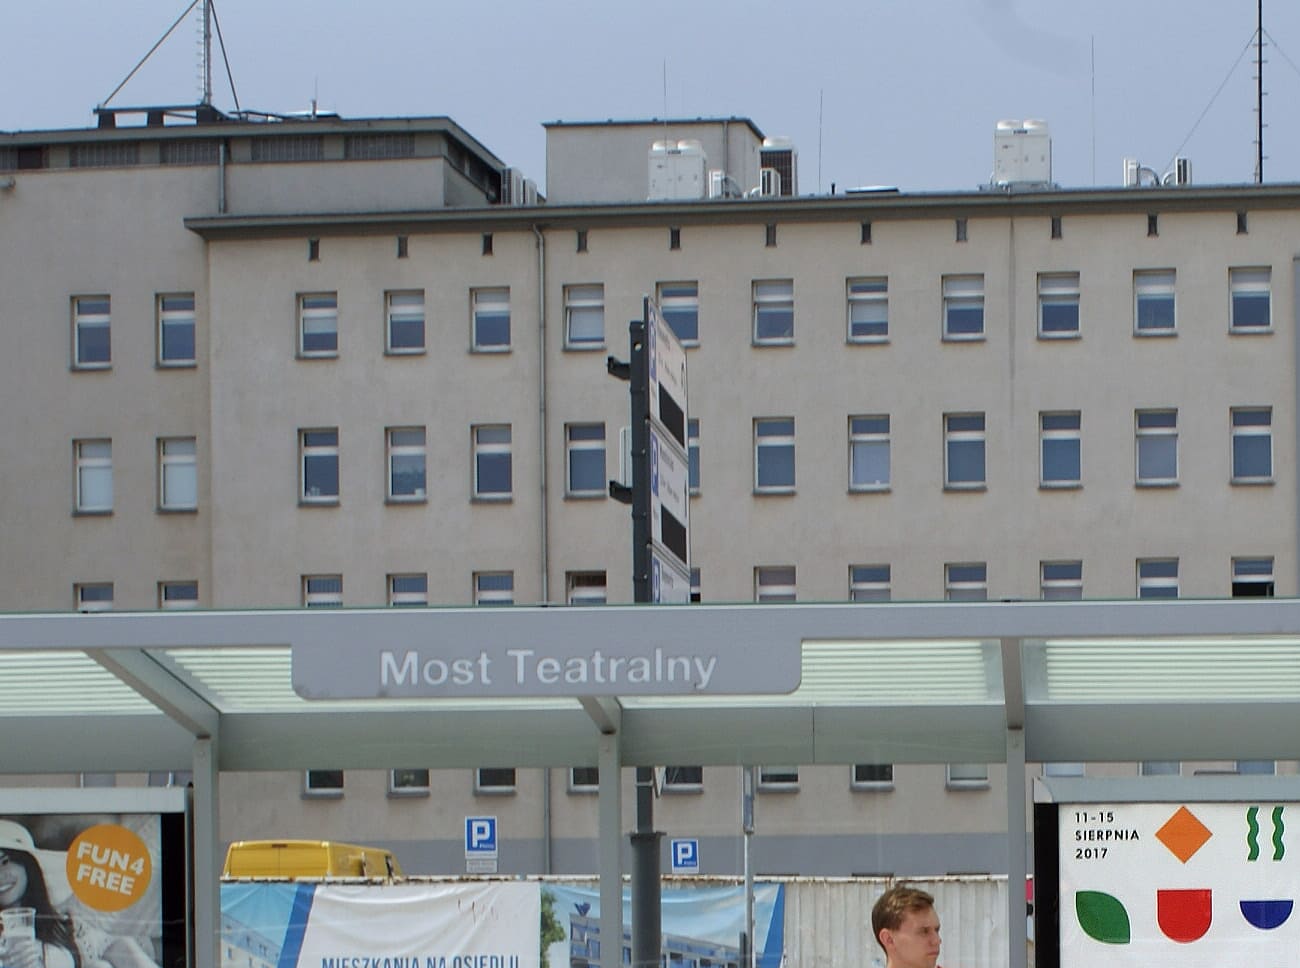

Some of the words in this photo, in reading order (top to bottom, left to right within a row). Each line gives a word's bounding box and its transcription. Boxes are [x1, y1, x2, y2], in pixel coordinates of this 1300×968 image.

[380, 650, 491, 686] Most
[507, 647, 717, 690] Teatralny
[472, 820, 490, 849] P
[1075, 829, 1139, 841] SIERPNIA
[677, 842, 693, 865] P
[1075, 848, 1107, 859] 2017
[77, 863, 135, 896] FREE
